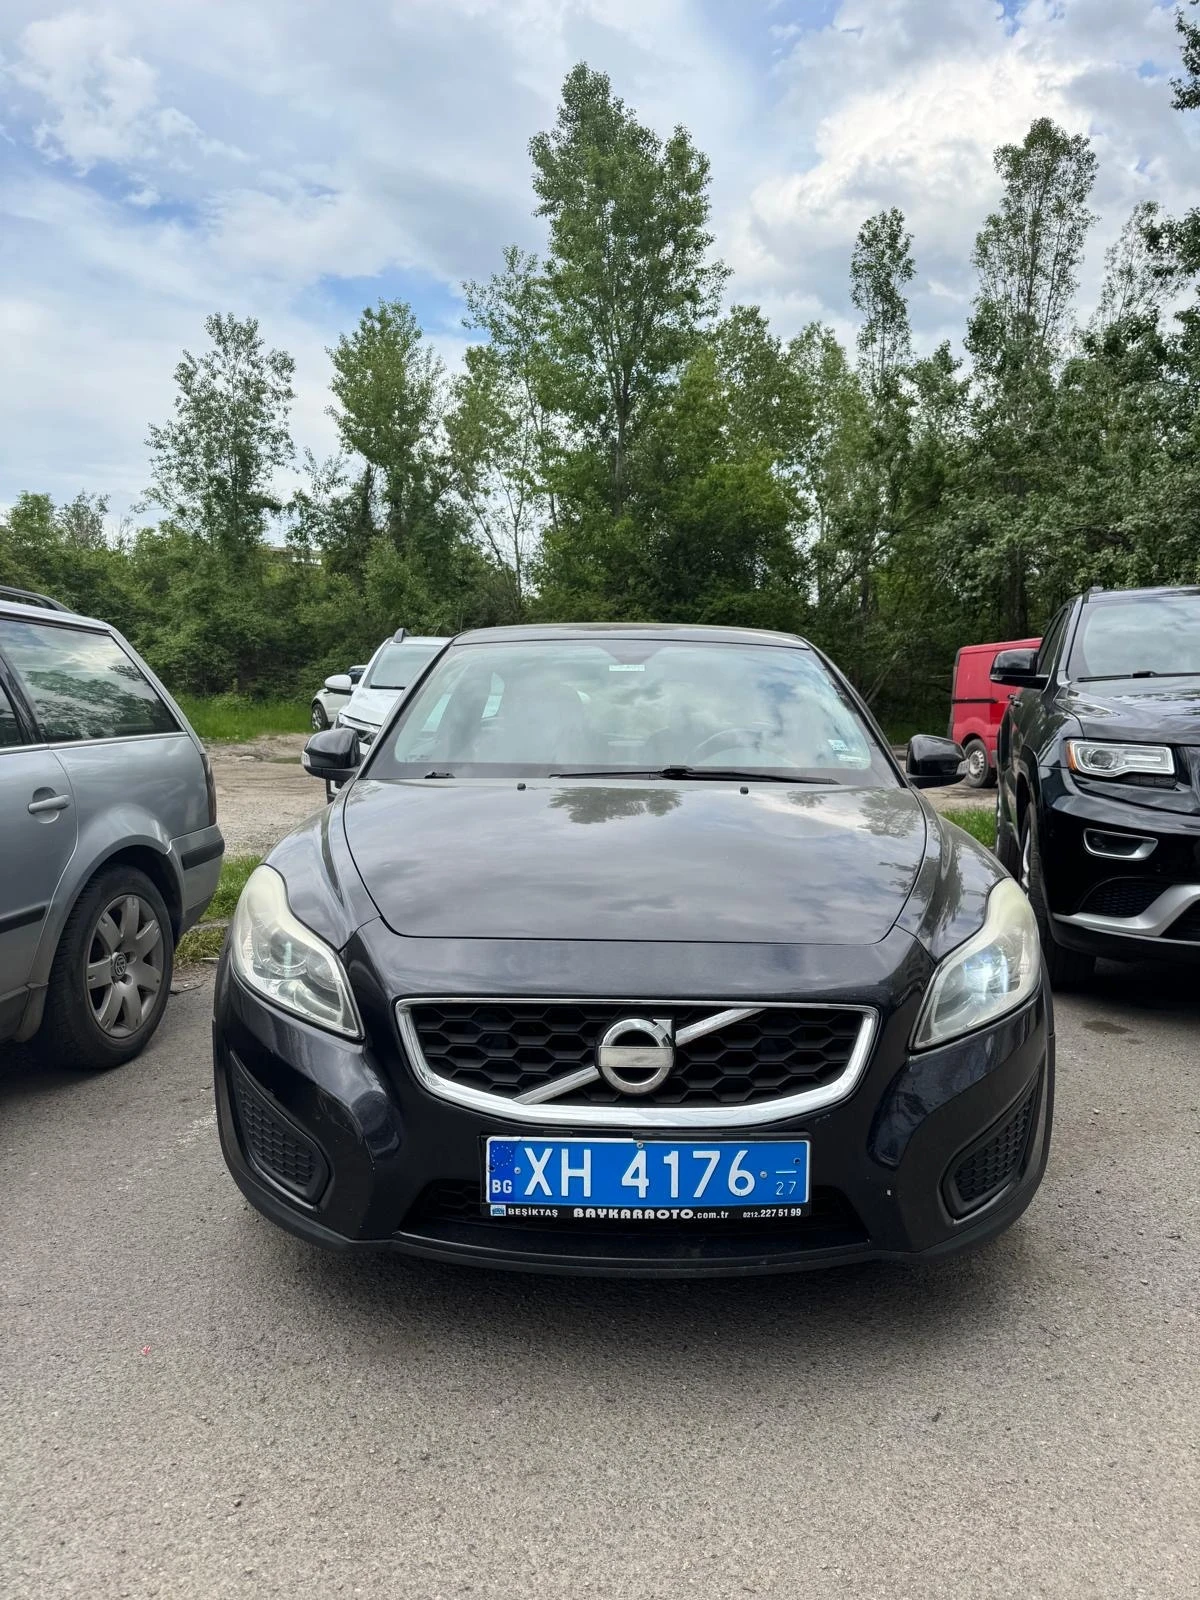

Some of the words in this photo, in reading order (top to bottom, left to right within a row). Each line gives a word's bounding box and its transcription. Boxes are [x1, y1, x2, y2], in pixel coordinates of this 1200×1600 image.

[524, 1147, 592, 1197] XH
[621, 1149, 756, 1199] 4176
[491, 1179, 513, 1194] BG
[775, 1180, 797, 1196] 27
[573, 1207, 729, 1220] BAYKARAOTO.com.tr
